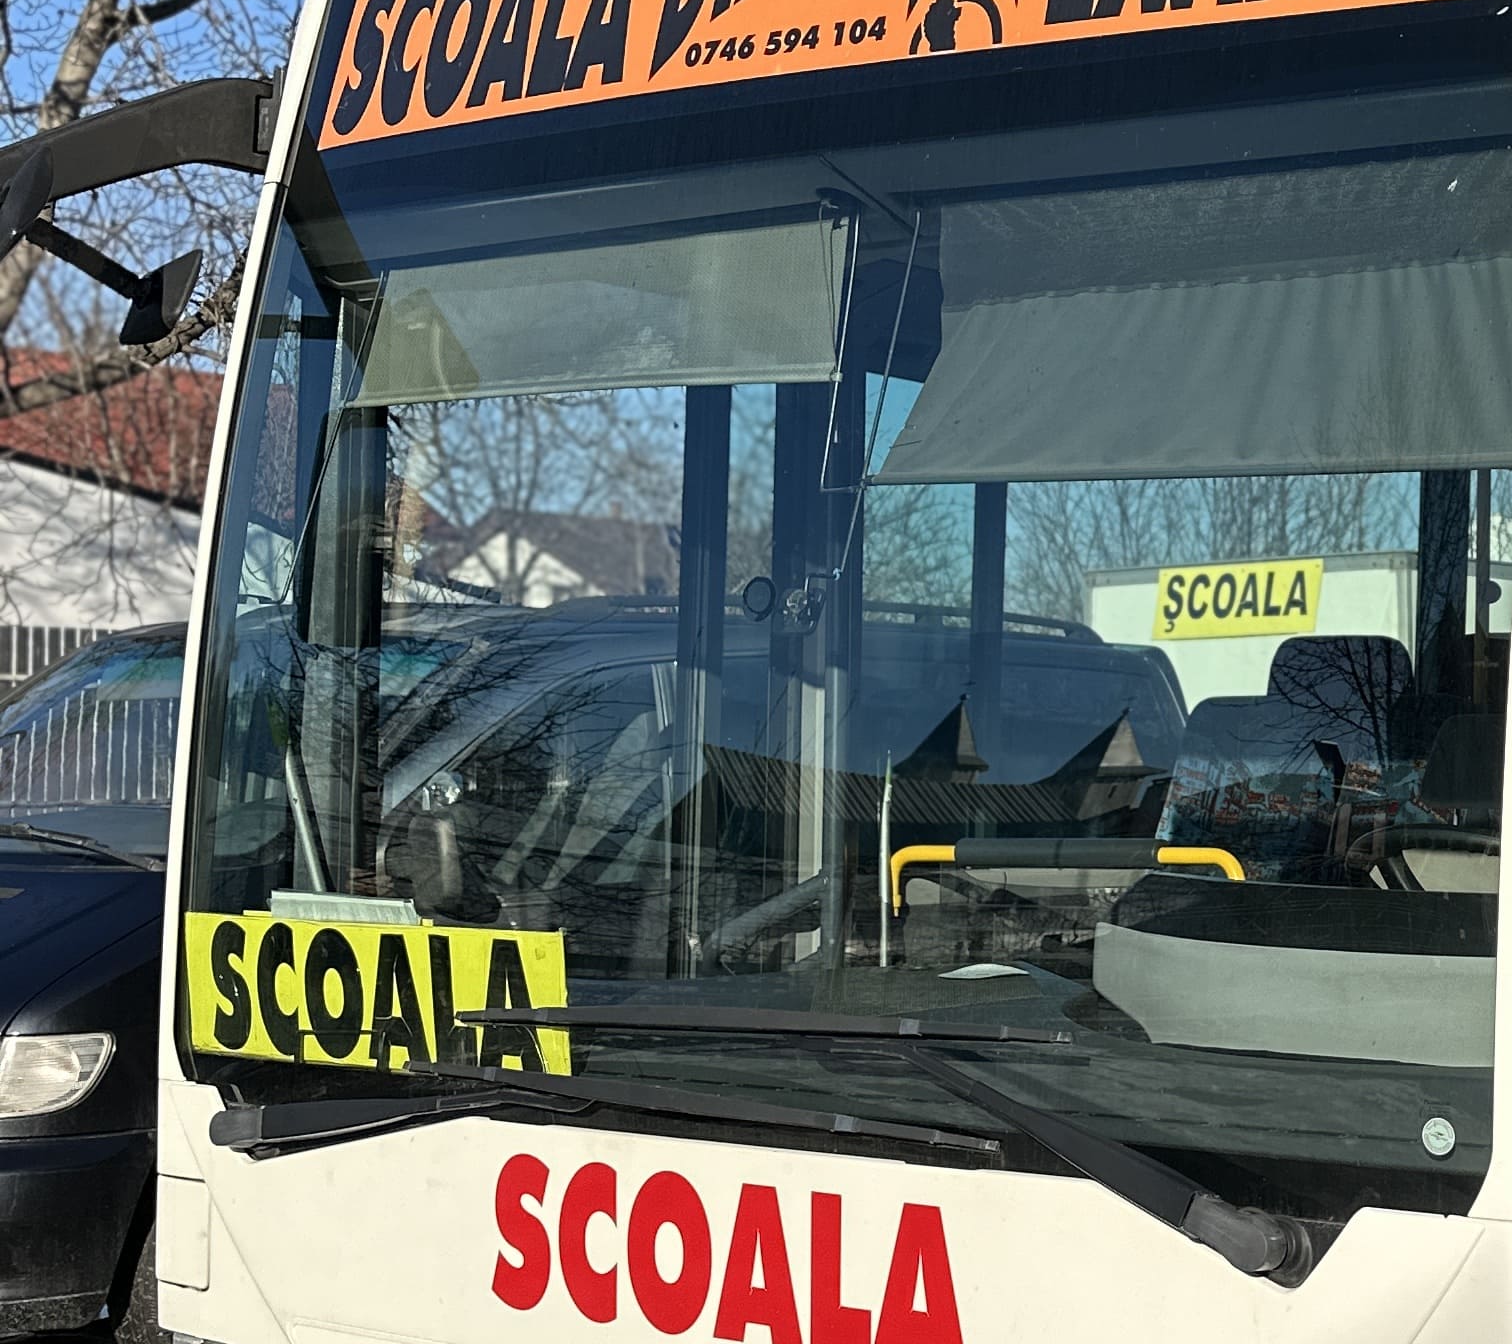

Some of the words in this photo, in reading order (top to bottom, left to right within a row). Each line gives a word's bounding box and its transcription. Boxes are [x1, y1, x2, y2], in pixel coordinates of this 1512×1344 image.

[685, 34, 755, 67] 0746
[764, 25, 820, 56] 594
[834, 16, 886, 46] 104
[211, 920, 549, 1074] SCOALA
